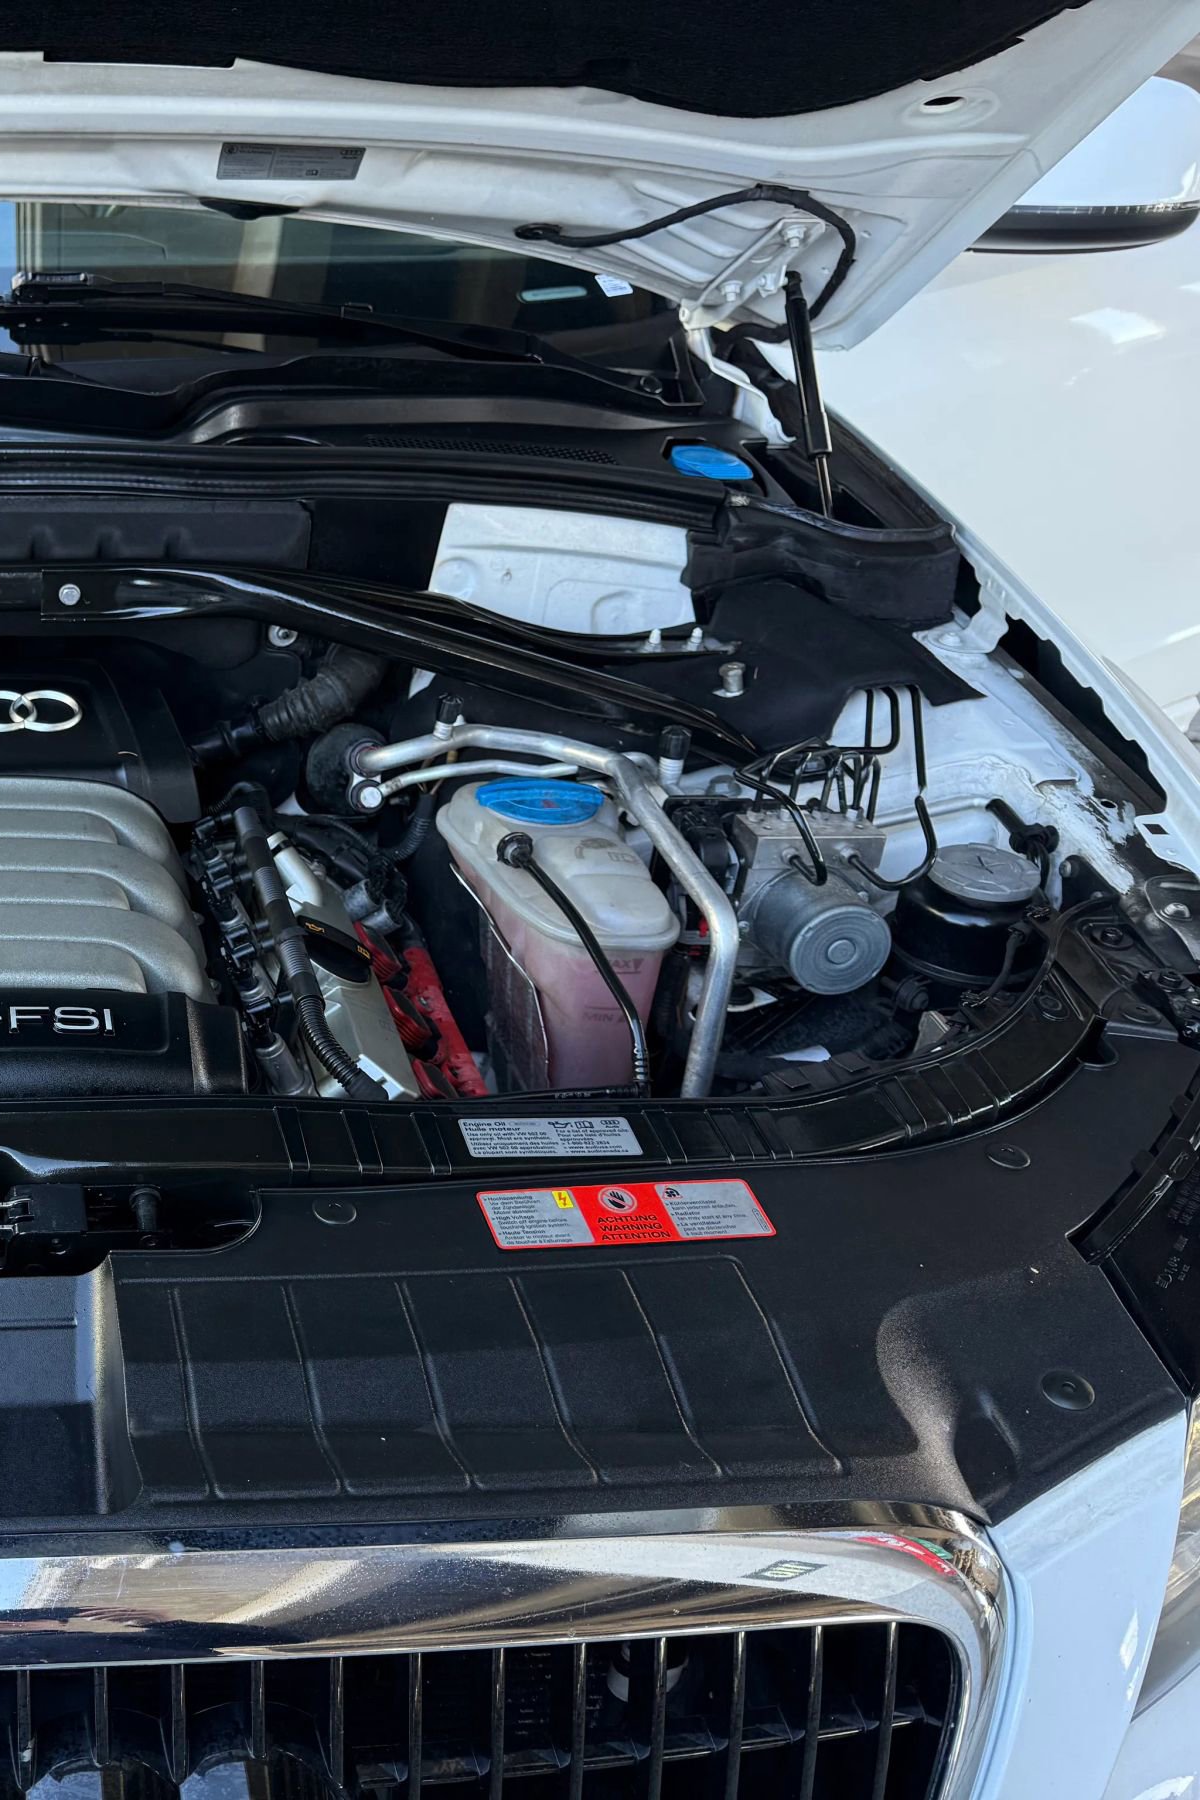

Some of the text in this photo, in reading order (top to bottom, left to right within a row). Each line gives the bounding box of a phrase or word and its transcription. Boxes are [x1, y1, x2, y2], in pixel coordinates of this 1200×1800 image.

[597, 1214, 658, 1224] ACHTUNG
[600, 1222, 663, 1232] WARNING
[601, 1231, 671, 1241] ATTENTION
